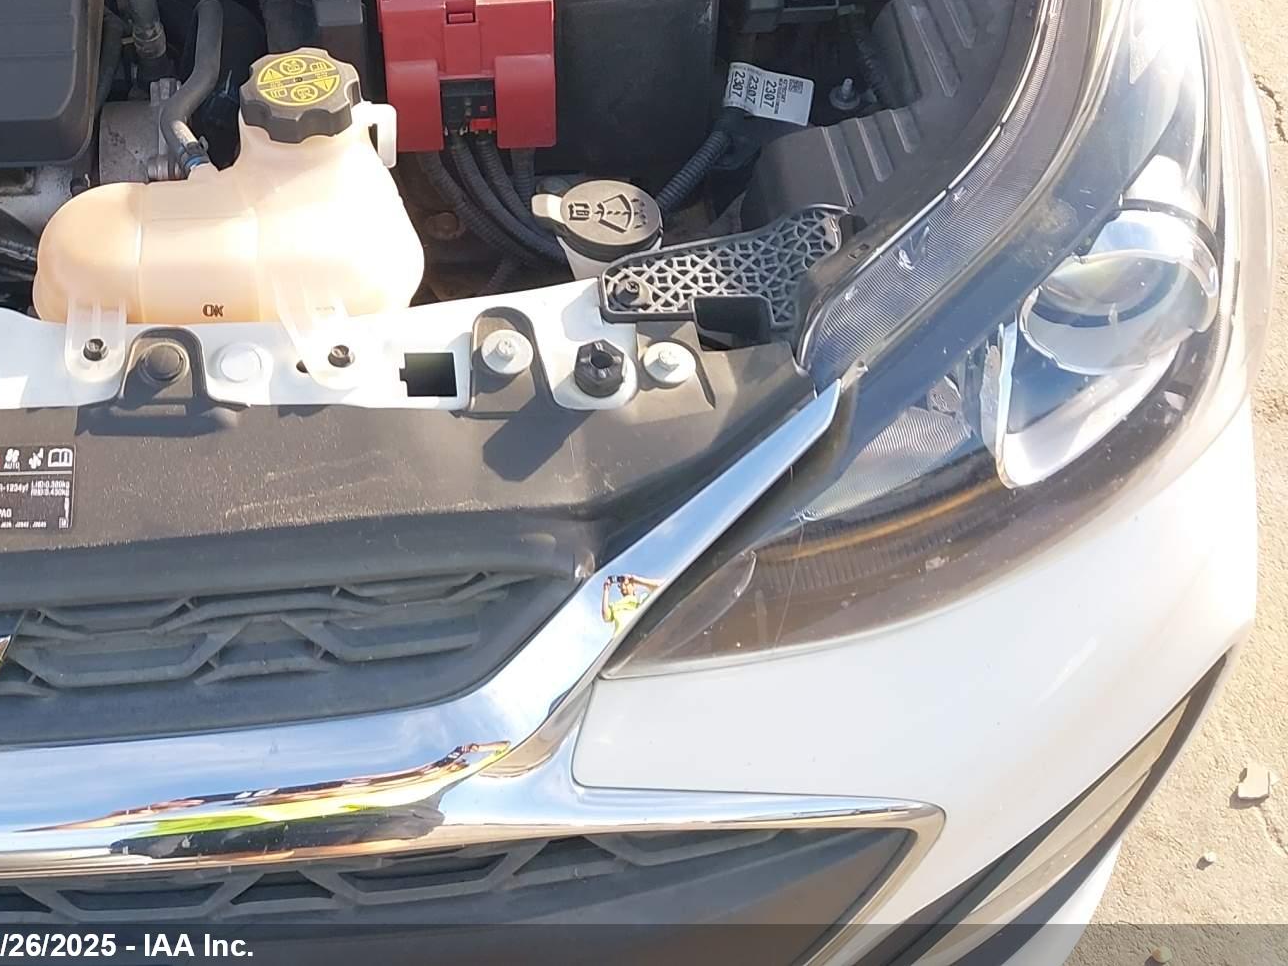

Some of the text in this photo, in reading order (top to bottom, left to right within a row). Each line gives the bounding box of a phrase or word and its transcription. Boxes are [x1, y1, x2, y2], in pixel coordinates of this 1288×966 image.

[731, 70, 746, 98] 2307
[746, 76, 760, 104] 2307
[763, 80, 777, 108] 2307
